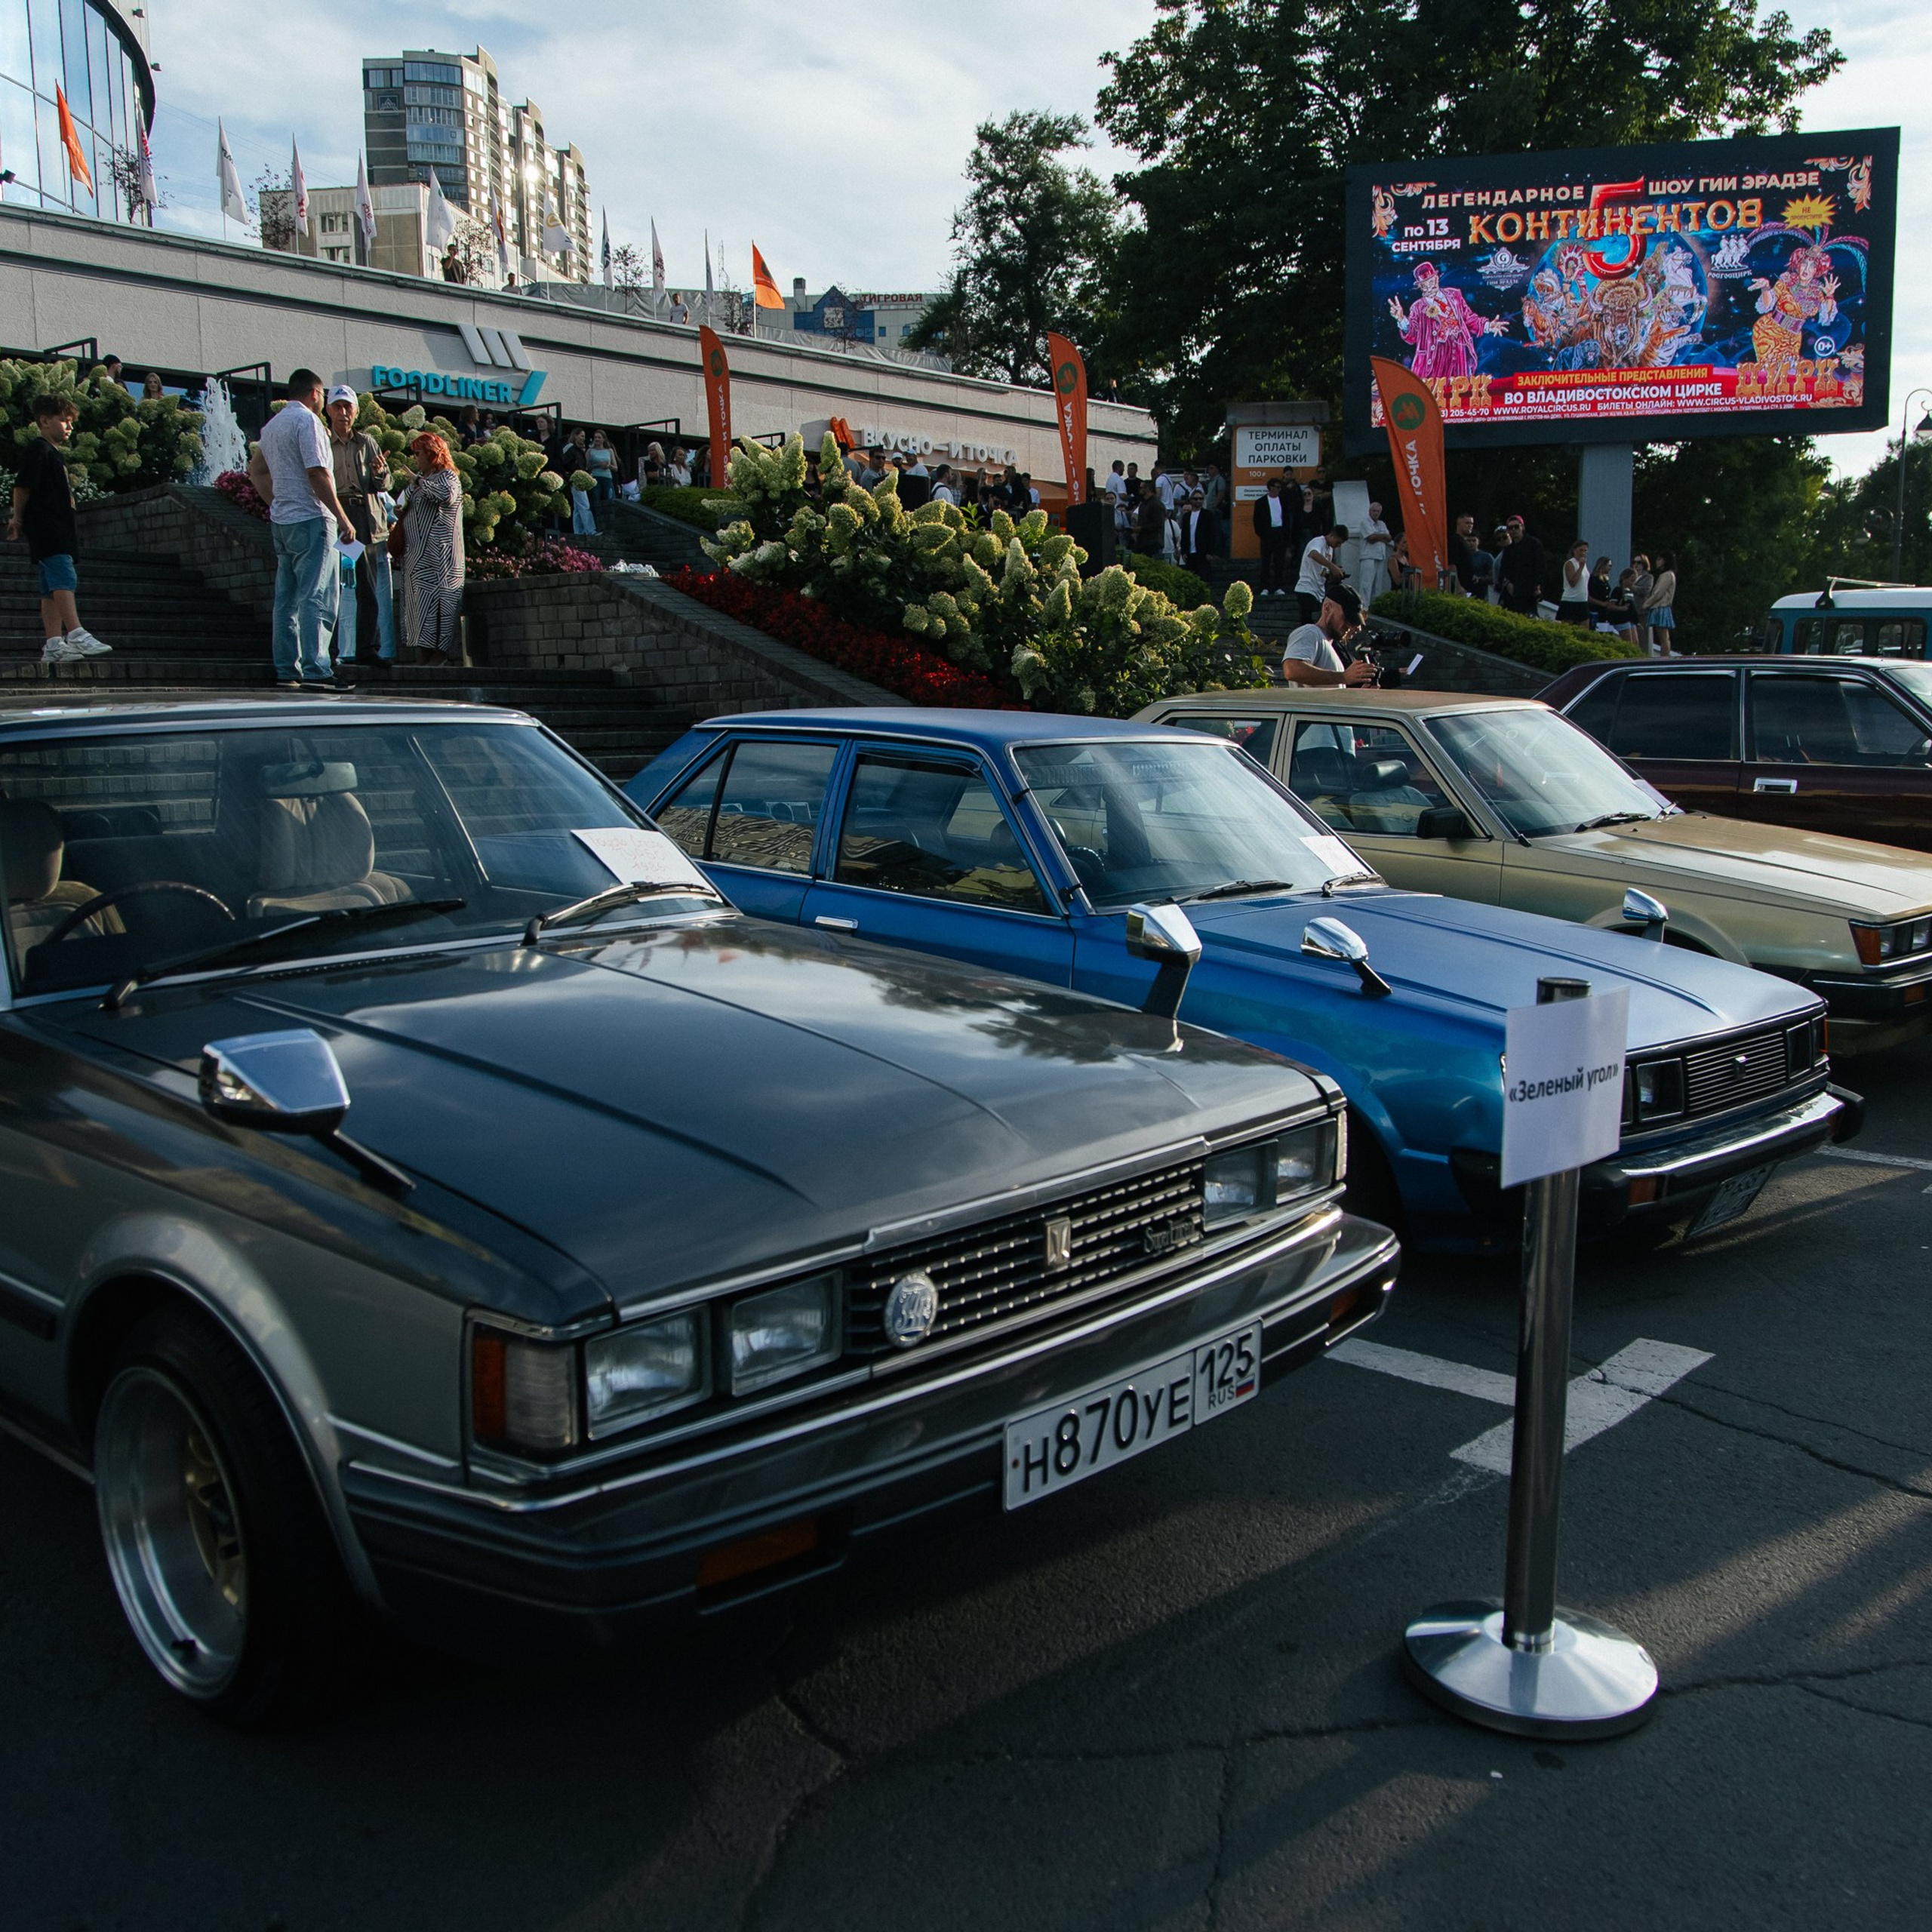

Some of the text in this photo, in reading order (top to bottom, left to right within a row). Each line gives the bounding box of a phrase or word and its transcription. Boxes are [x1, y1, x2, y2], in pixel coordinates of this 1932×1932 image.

[1648, 171, 1820, 195] ШОУ ГИИ ЭРАДЗЕ
[1422, 186, 1584, 209] ЛЕГЕНДАРНОЕ
[1426, 218, 1448, 236] 13
[1469, 198, 1764, 245] КОНТИНЕНТОВ
[1391, 238, 1461, 252] СЕНТЯБРЯ
[861, 293, 923, 303] ТИГРОВАЯ
[1817, 342, 1832, 352] 0+
[372, 365, 512, 403] FOODLINER
[1517, 368, 1708, 386] ЗАКЛЮЧИТЕЛЬНЫЕ ПРЕДСТАВЛЕНИЯ
[1737, 358, 1840, 397] ЦИРК
[1424, 374, 1493, 408] ИРК
[1504, 383, 1722, 405] ВО ВЛАДИВОСТОКСКОМ ЦИРКЕ
[718, 383, 727, 429] ТОЧКА
[1450, 408, 1490, 417] 205-45-70
[1493, 403, 1591, 415] WWW.ROYALCIRCUS.RU
[1597, 394, 1813, 411] БИЛЕТЫ ОНЛАЙН: WWW.CIRCUS-VLADIVOSTOK.RU
[1063, 401, 1073, 449] ОЧКА
[1248, 430, 1308, 440] ТЕРМИНАЛ
[863, 427, 934, 454] ВКУСНО
[964, 443, 1017, 466] ТОЧКА
[1254, 442, 1301, 452] ОПЛАТЫ
[1248, 454, 1307, 463] ПАРКОВКИ
[1509, 1063, 1619, 1103] «Зеленый угол»
[1208, 1384, 1235, 1410] RUS
[1023, 1329, 1256, 1494] Н870УЕ 125
